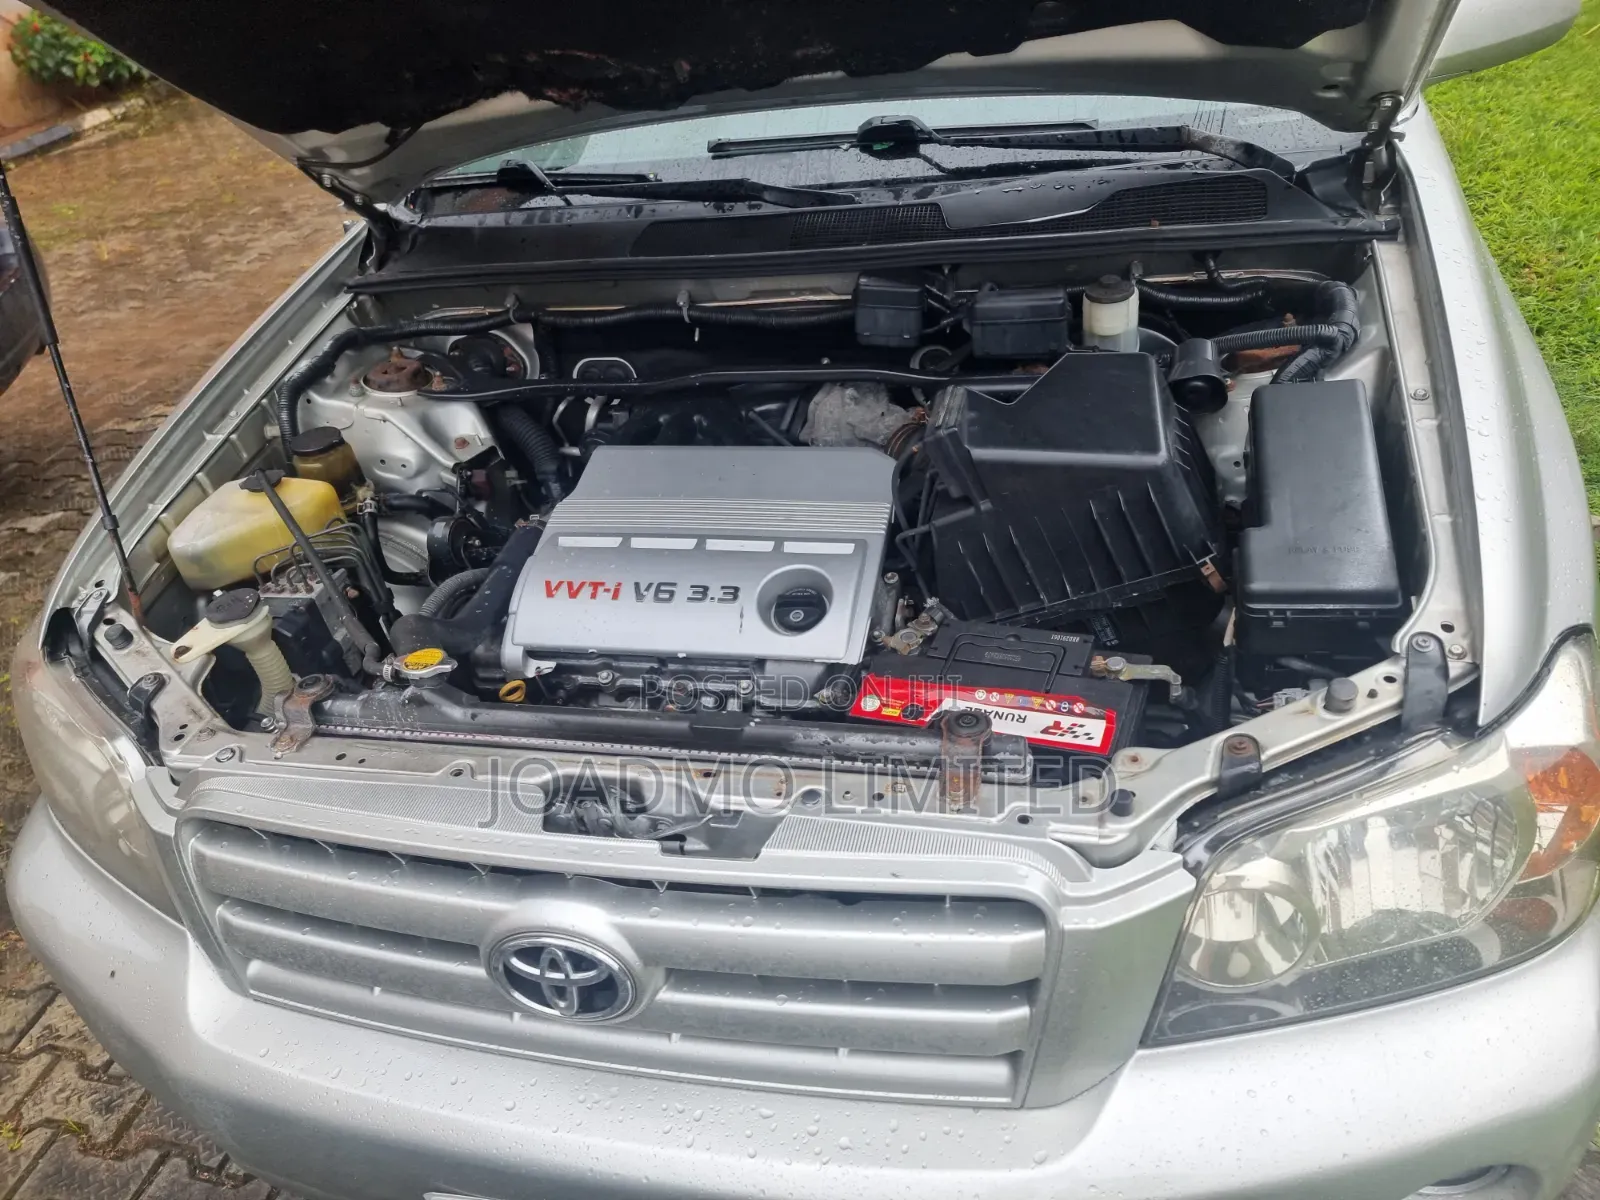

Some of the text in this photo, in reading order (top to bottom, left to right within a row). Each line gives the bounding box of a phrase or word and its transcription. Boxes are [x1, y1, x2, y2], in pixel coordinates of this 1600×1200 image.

[544, 580, 740, 604] VVT-i V6 3.3
